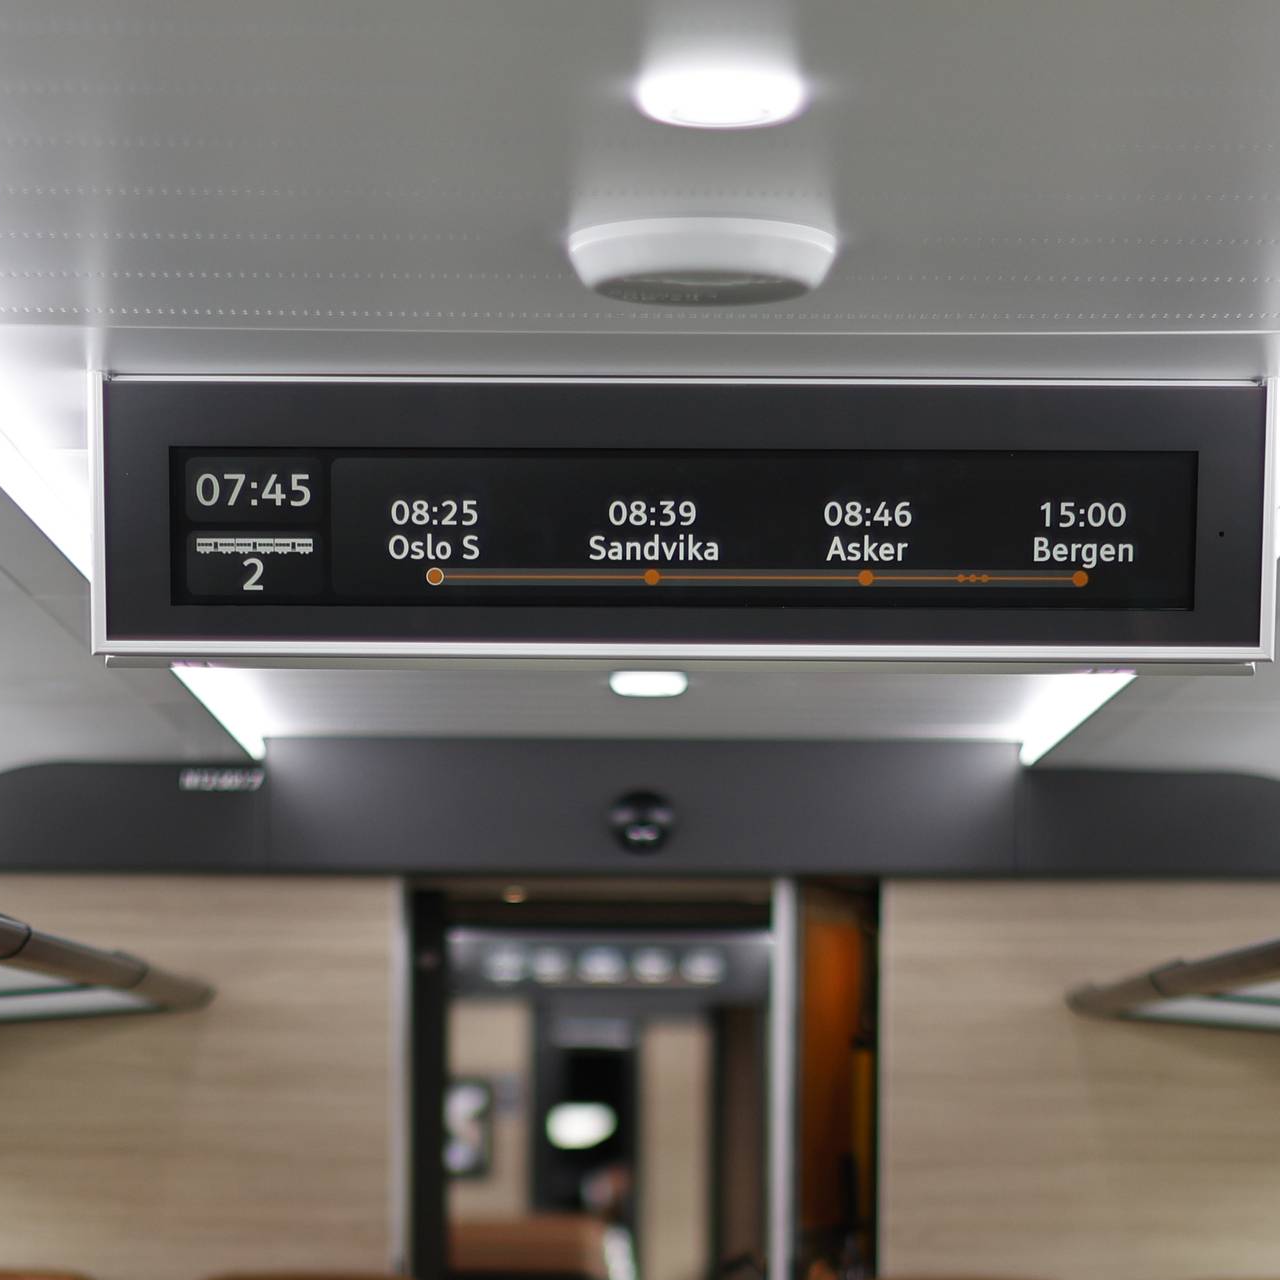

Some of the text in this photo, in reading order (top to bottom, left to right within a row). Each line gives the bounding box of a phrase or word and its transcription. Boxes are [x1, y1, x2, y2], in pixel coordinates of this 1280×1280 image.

[195, 473, 312, 507] 07:45
[390, 499, 478, 526] 08:25
[608, 500, 697, 527] 08:39
[823, 501, 912, 528] 08:46
[1040, 502, 1127, 528] 15:00
[388, 532, 480, 560] Oslo S
[589, 533, 719, 562] Sandvika
[825, 534, 909, 562] Asker
[1033, 536, 1134, 569] Bergen
[242, 557, 264, 591] 2
